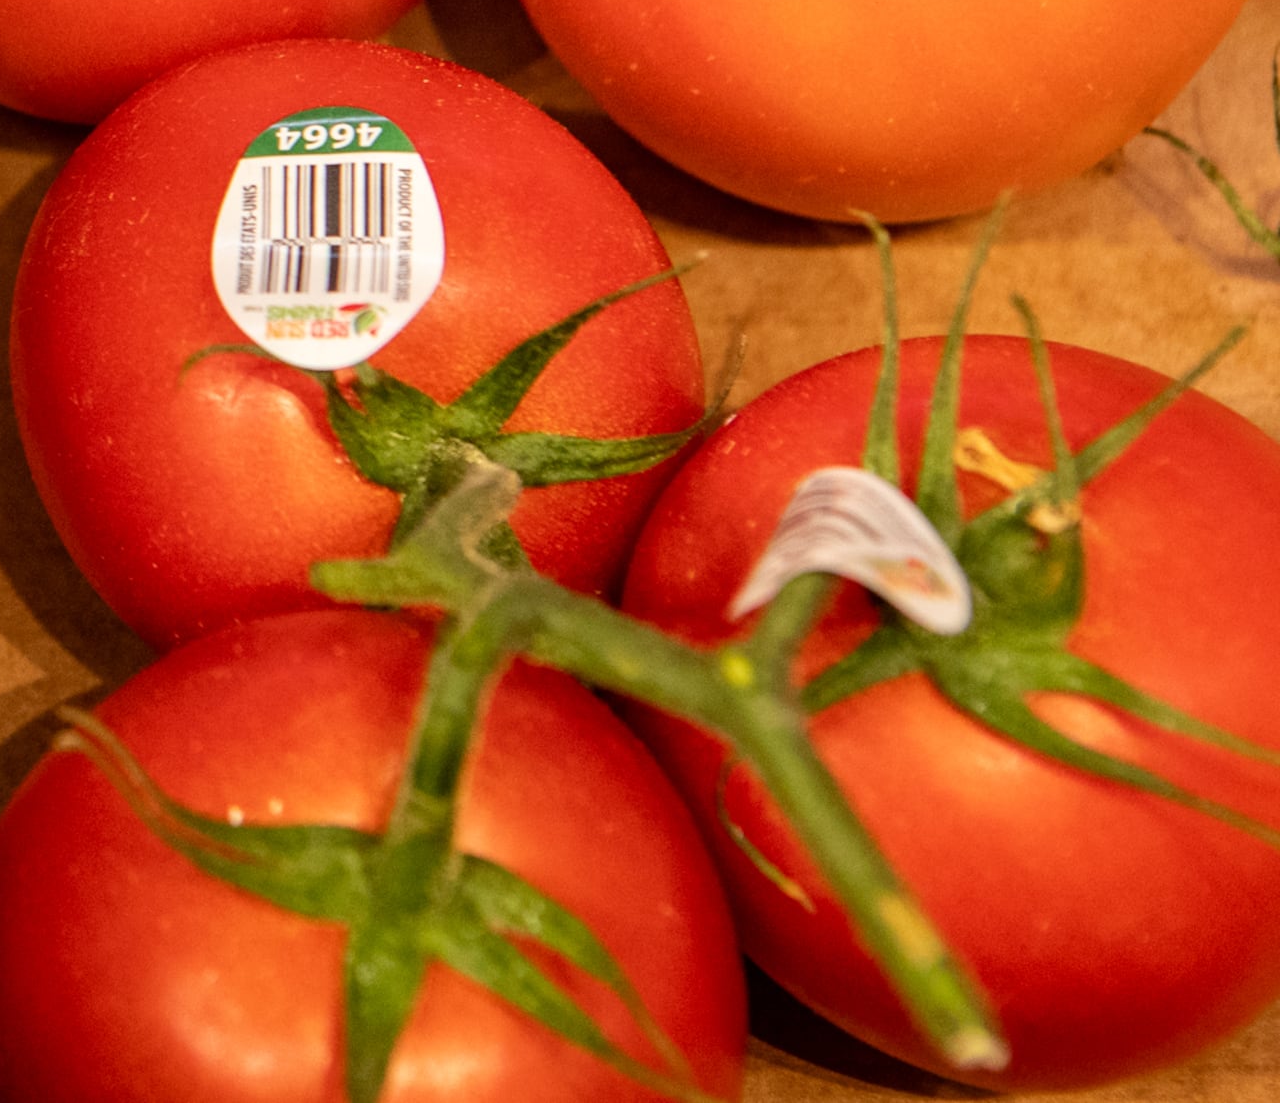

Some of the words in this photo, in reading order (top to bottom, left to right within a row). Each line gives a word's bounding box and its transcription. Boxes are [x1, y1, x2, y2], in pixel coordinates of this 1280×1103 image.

[275, 121, 383, 151] 4664
[397, 168, 412, 218] PRODUCT
[398, 220, 412, 232] OF
[398, 236, 412, 251] THE
[239, 246, 254, 261] DES
[311, 320, 350, 339] RED
